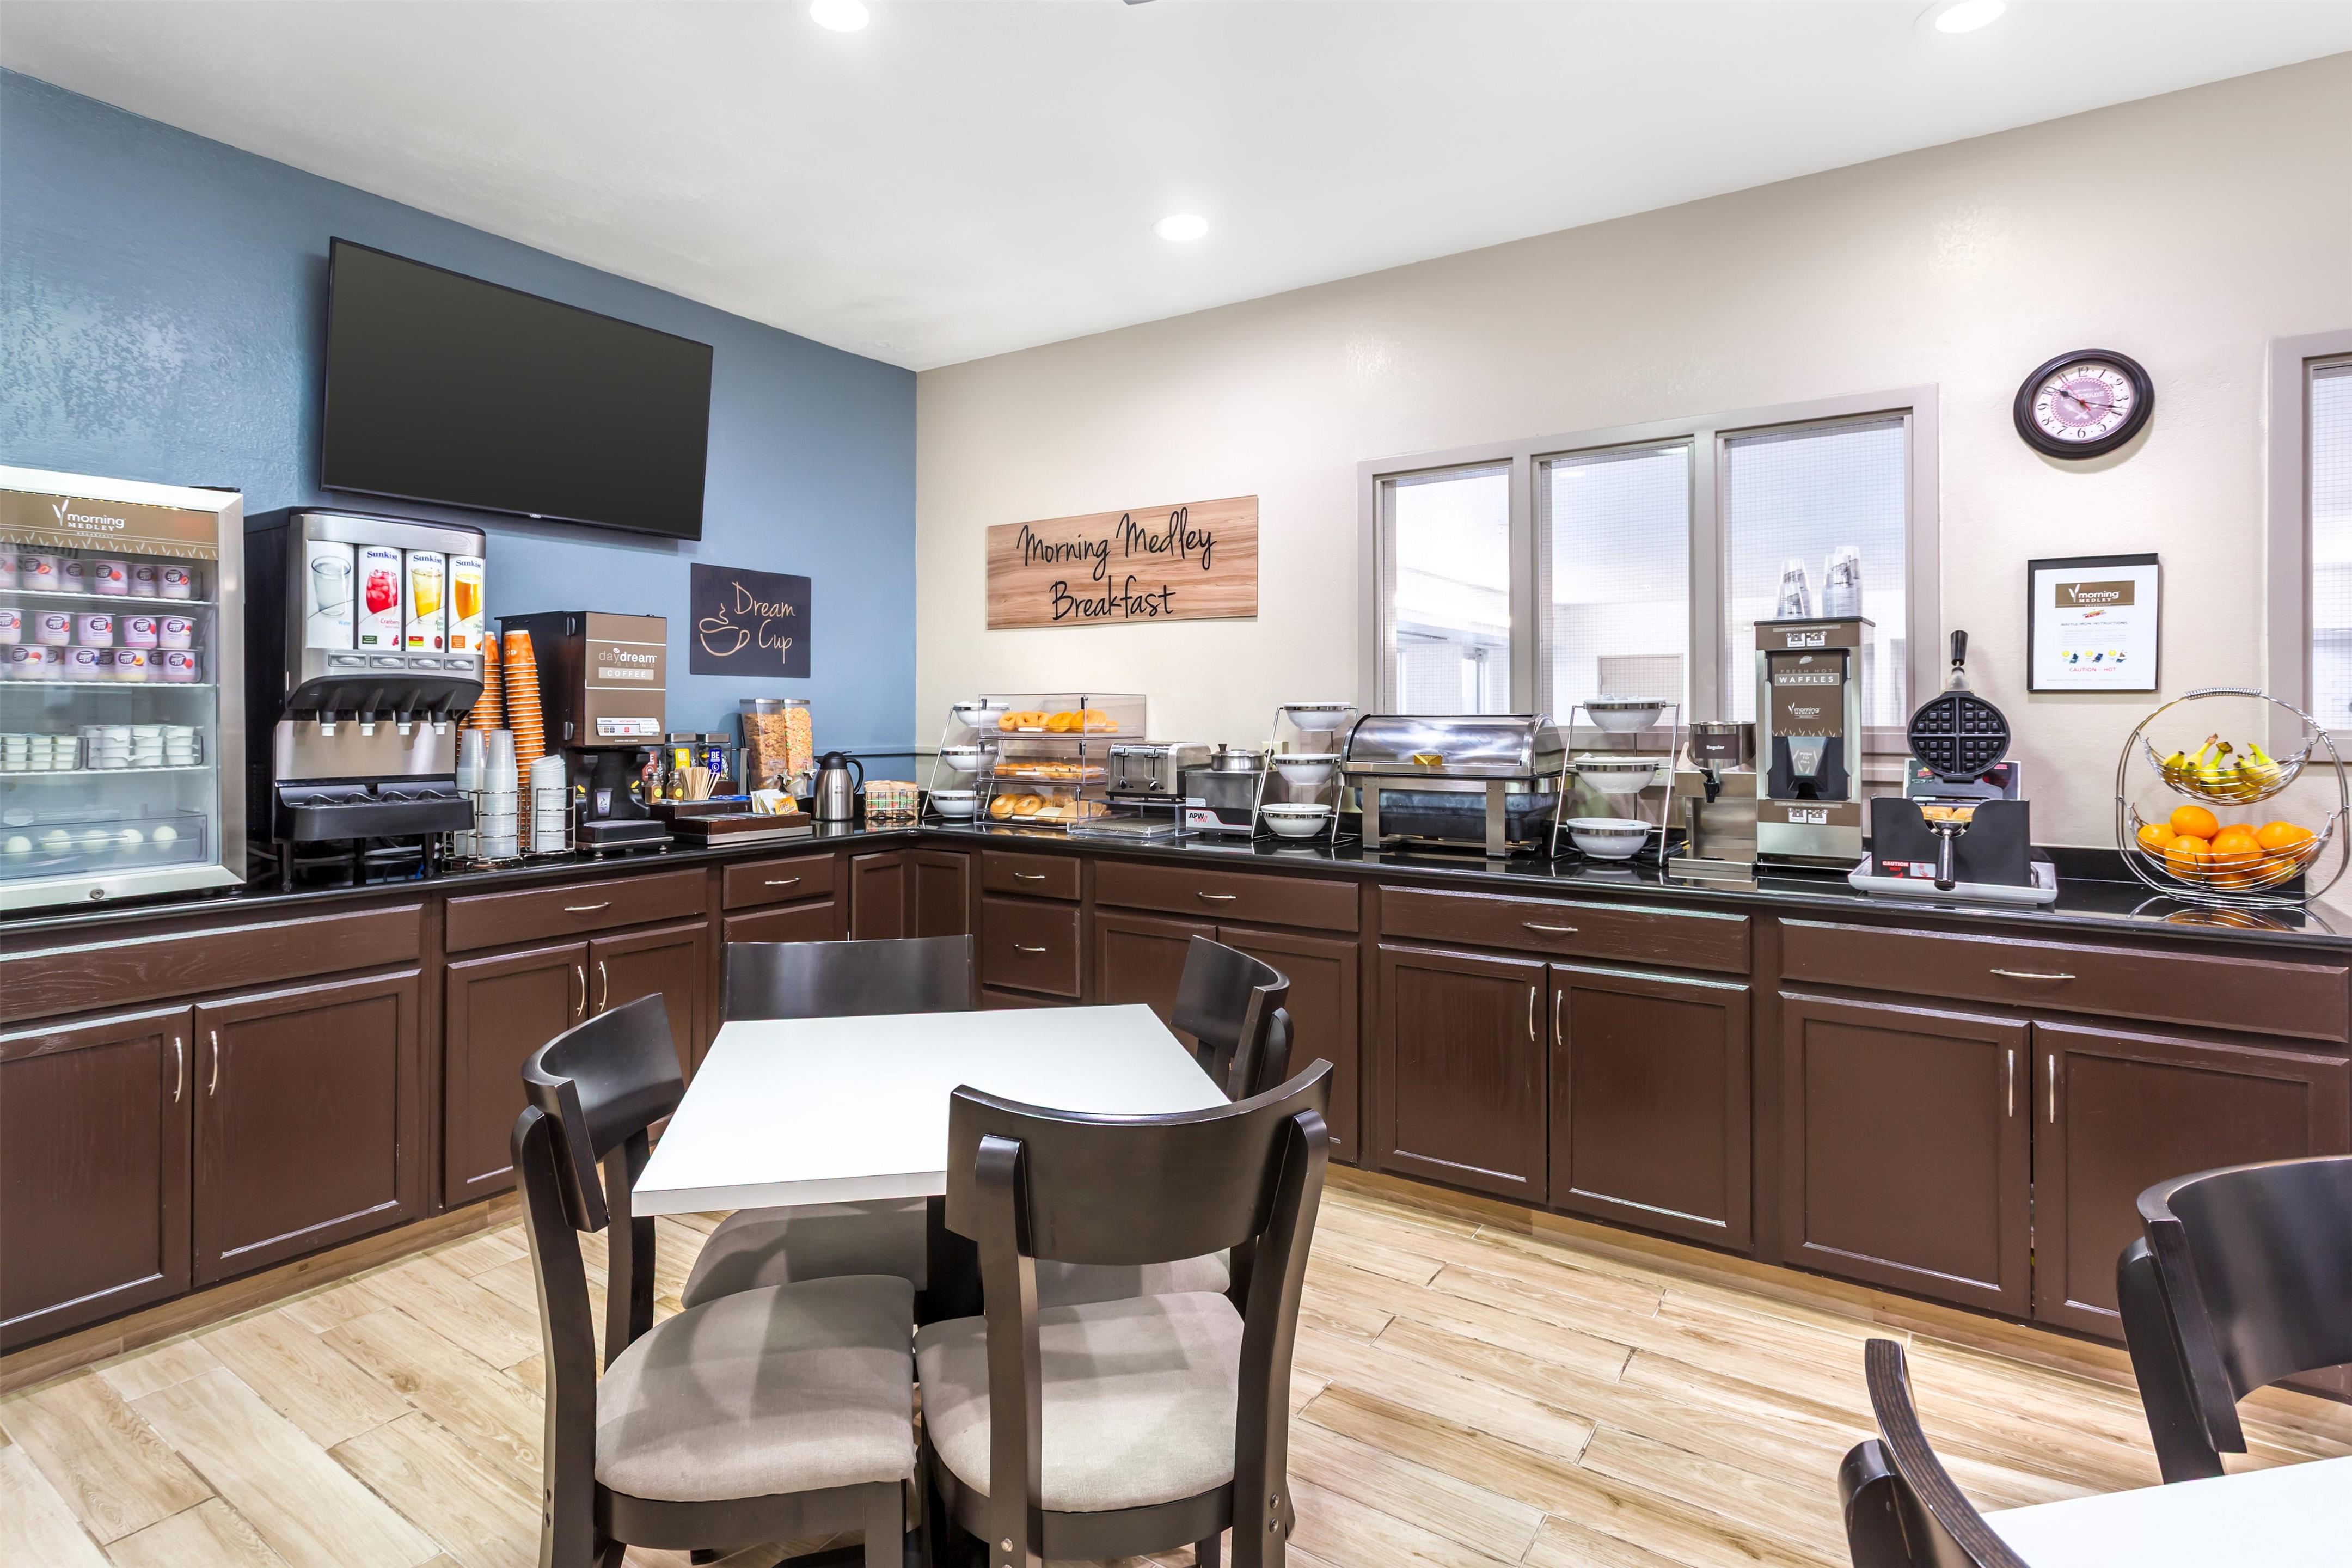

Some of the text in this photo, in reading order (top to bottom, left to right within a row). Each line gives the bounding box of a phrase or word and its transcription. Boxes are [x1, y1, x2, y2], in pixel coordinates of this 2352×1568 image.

[2078, 366, 2089, 377] 12
[2099, 369, 2106, 378] 1
[2109, 378, 2123, 388] 2
[2041, 416, 2054, 426] 8
[2057, 425, 2068, 436] 7
[2096, 422, 2106, 432] 5
[2077, 428, 2086, 438] 6
[67, 514, 124, 529] morning
[68, 522, 114, 531] MEDLEY
[1016, 507, 1217, 581] Morning Medley
[367, 550, 397, 561] Sunkist
[413, 555, 442, 565] Sunkist
[456, 560, 481, 570] Sunkist
[732, 581, 796, 618] Dream
[1049, 575, 1176, 620] Breakfast
[2078, 591, 2119, 599] morning
[758, 619, 793, 664] Cup
[599, 651, 655, 664] daydream
